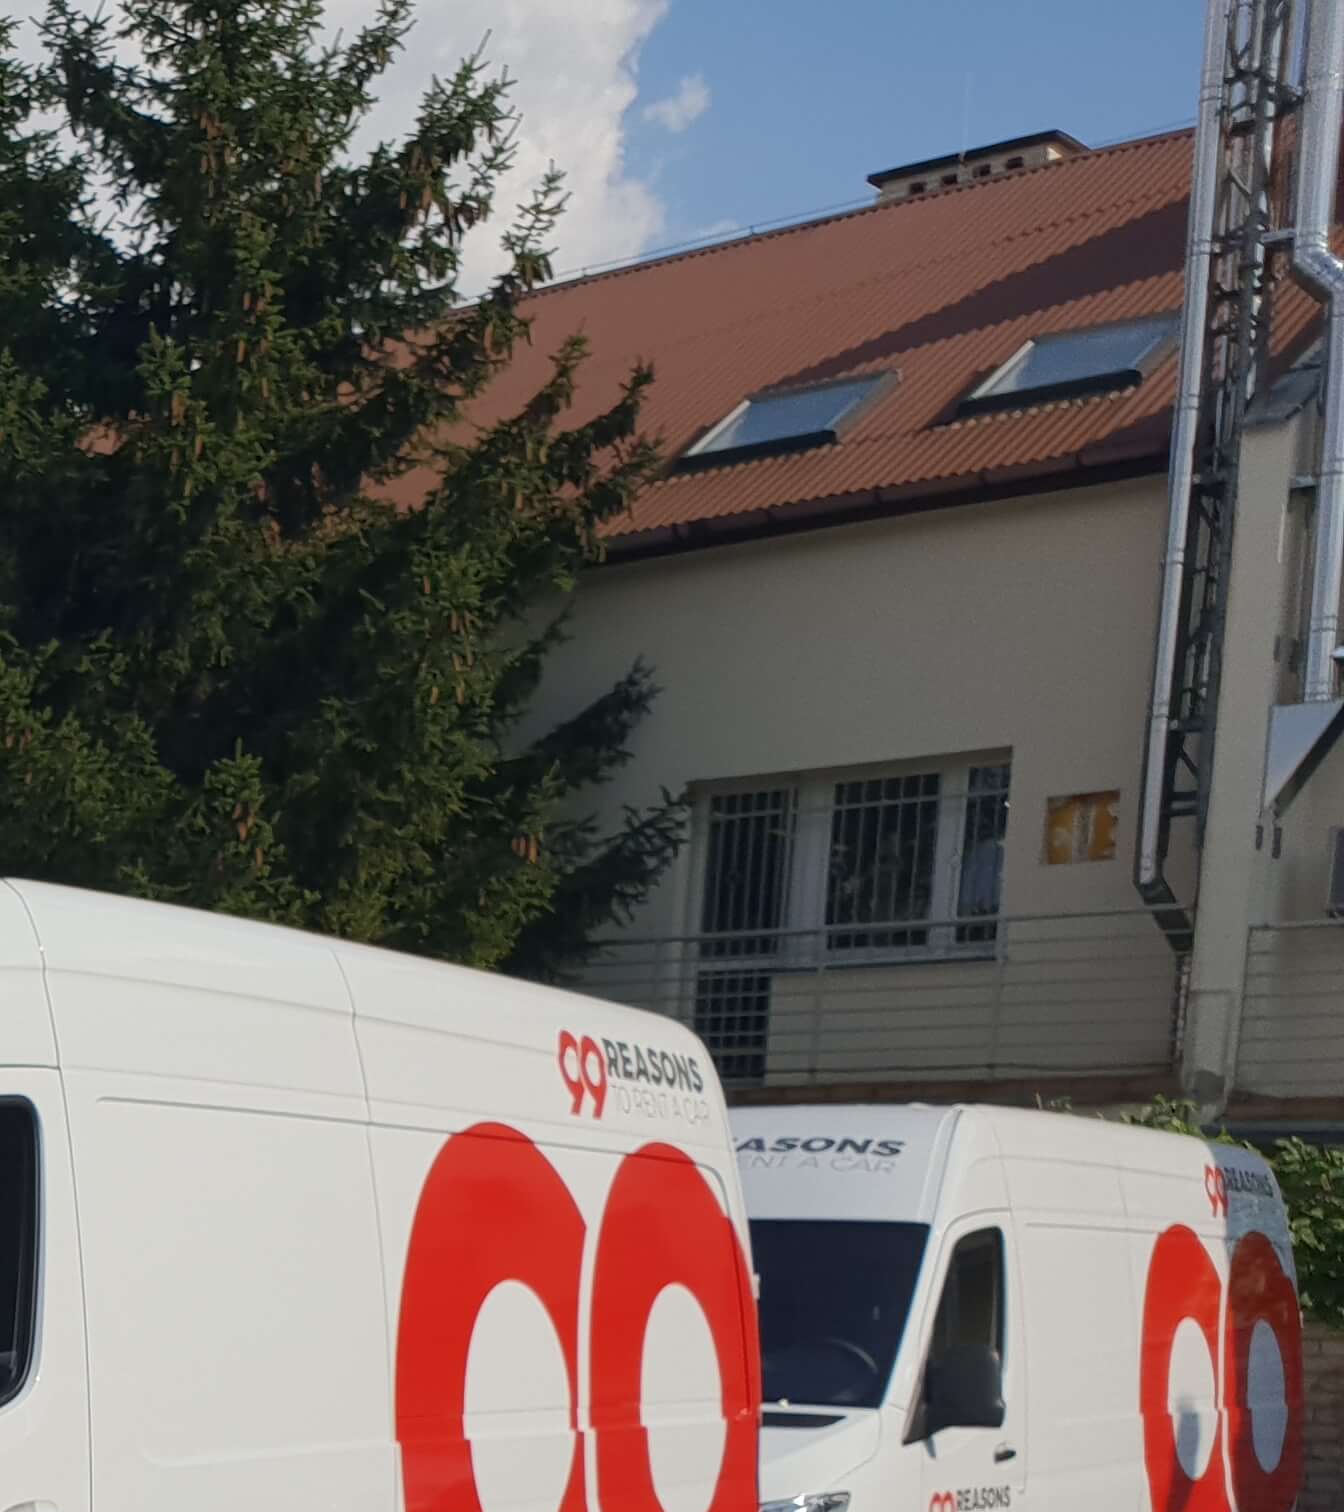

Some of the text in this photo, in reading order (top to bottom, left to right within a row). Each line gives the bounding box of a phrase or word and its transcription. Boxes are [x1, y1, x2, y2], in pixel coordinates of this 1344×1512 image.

[558, 1029, 703, 1119] 99 REASONS
[733, 1136, 906, 1157] ASONS
[956, 1485, 1011, 1512] REASONS
